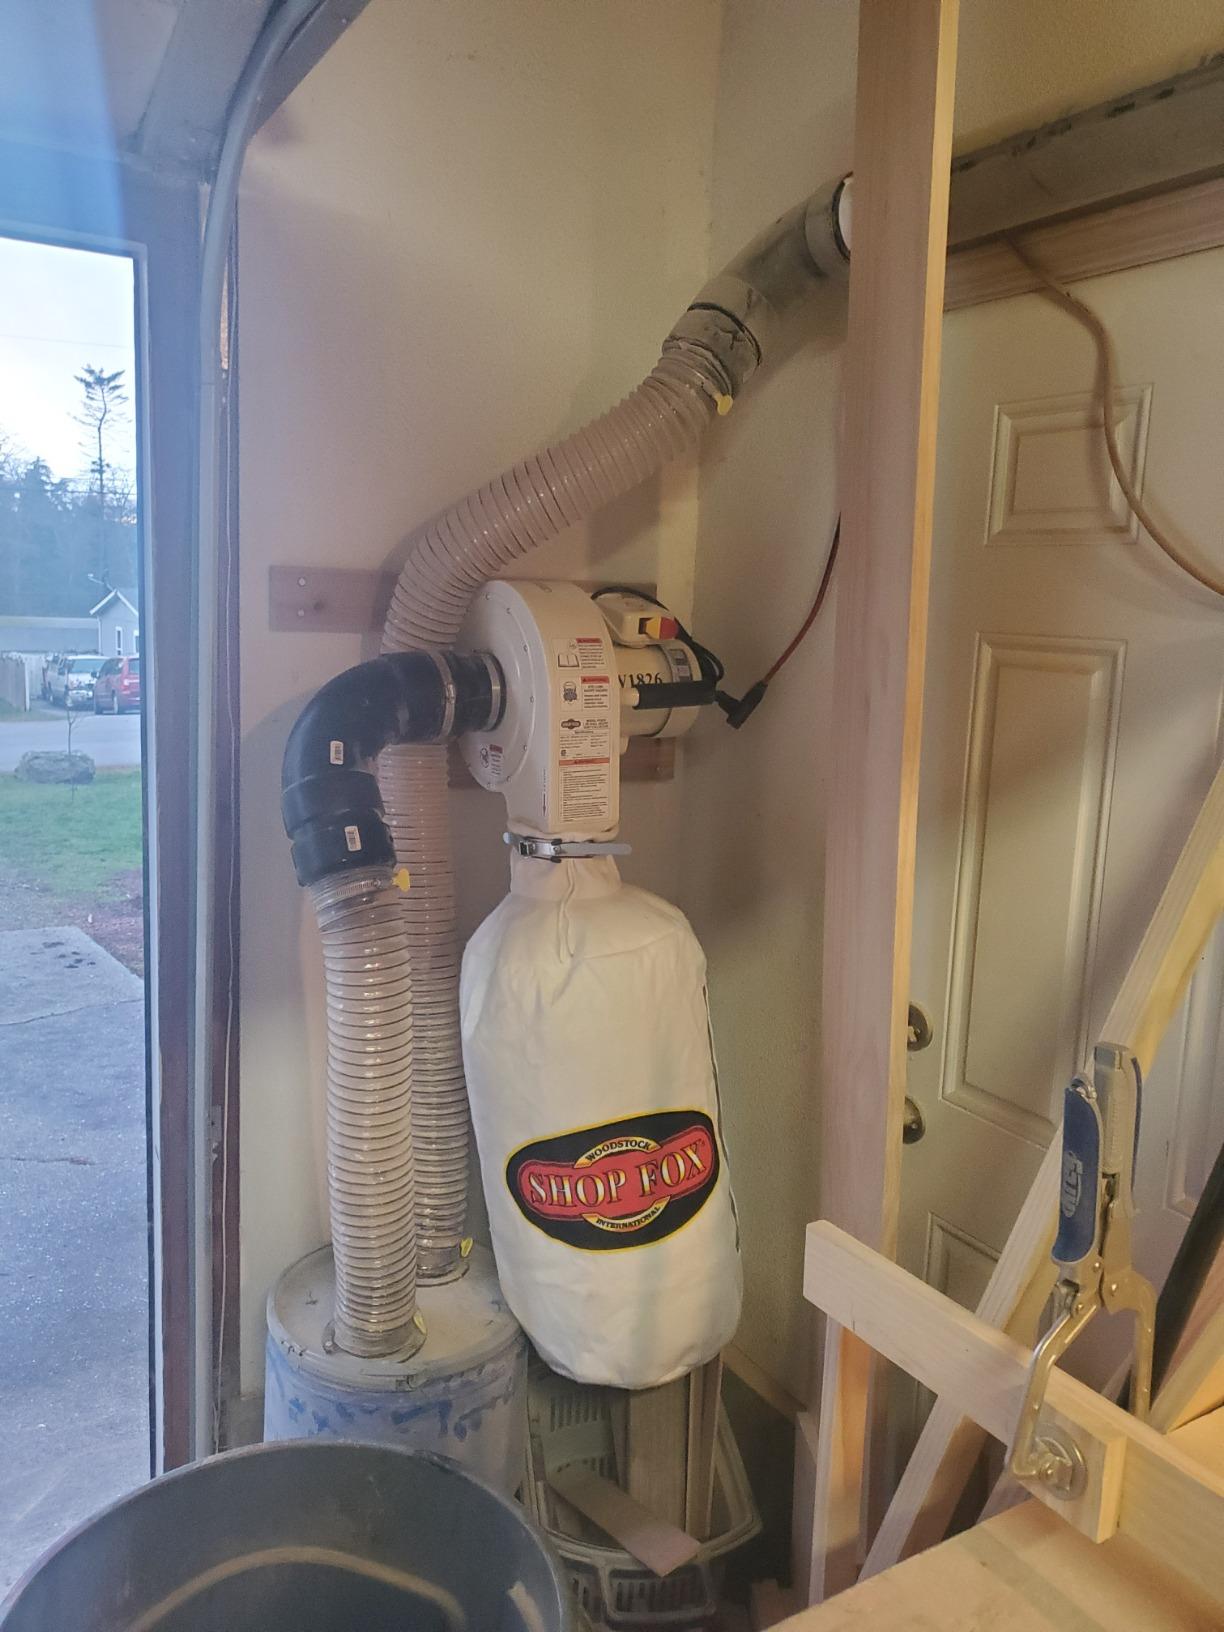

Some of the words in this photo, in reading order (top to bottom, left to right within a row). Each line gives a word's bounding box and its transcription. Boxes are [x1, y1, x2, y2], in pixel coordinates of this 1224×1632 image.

[586, 1139, 652, 1162] WOODSTOCK
[528, 1168, 627, 1208] SHOP
[634, 1138, 706, 1198] FOX
[595, 1205, 661, 1230] INTERNATIONAL
